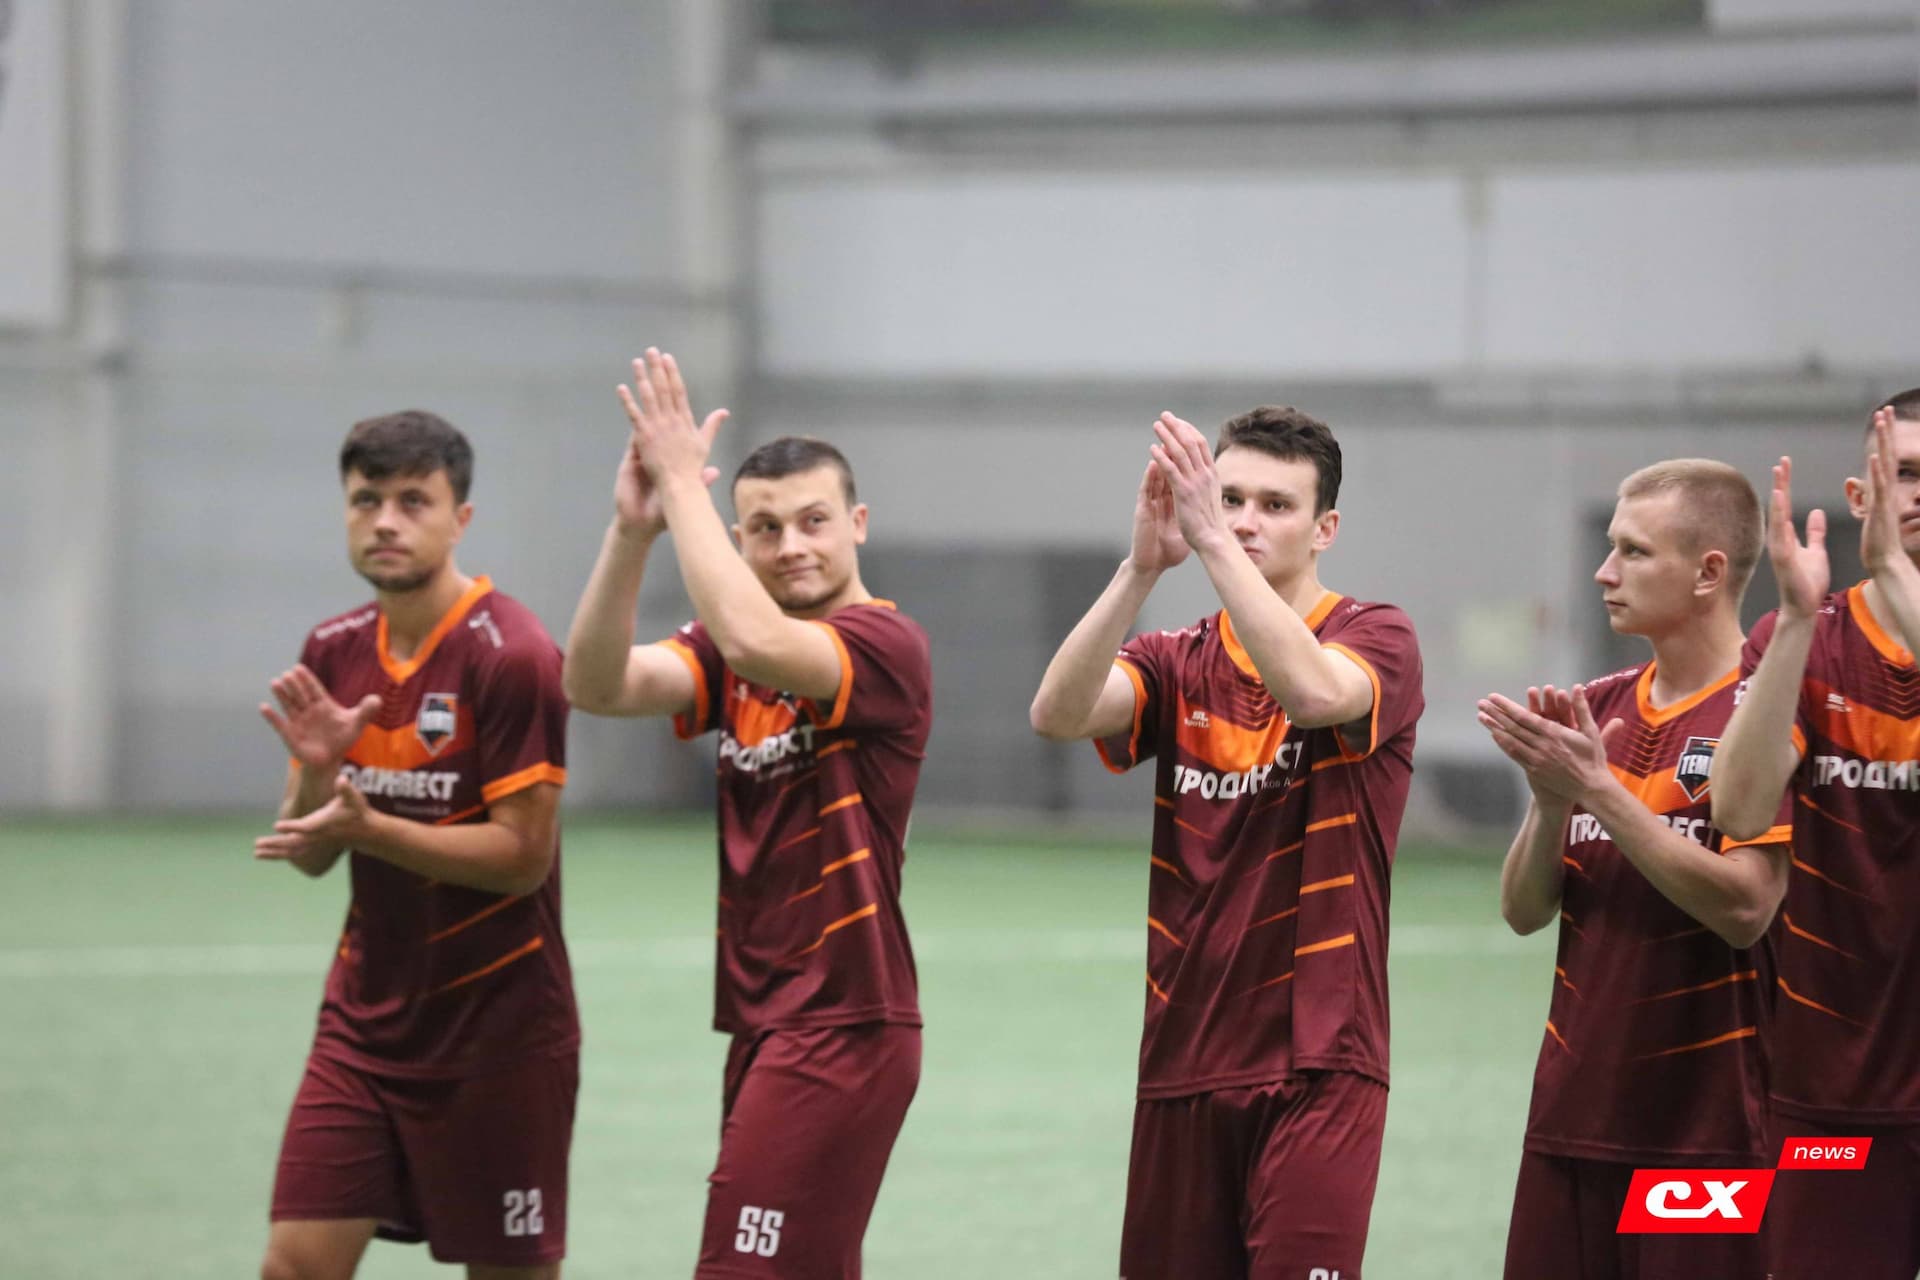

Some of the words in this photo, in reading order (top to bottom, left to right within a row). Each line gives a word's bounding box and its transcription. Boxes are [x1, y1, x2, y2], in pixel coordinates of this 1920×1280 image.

[1679, 753, 1711, 777] ТЕМ
[503, 1187, 544, 1237] 22
[734, 1205, 785, 1258] 55
